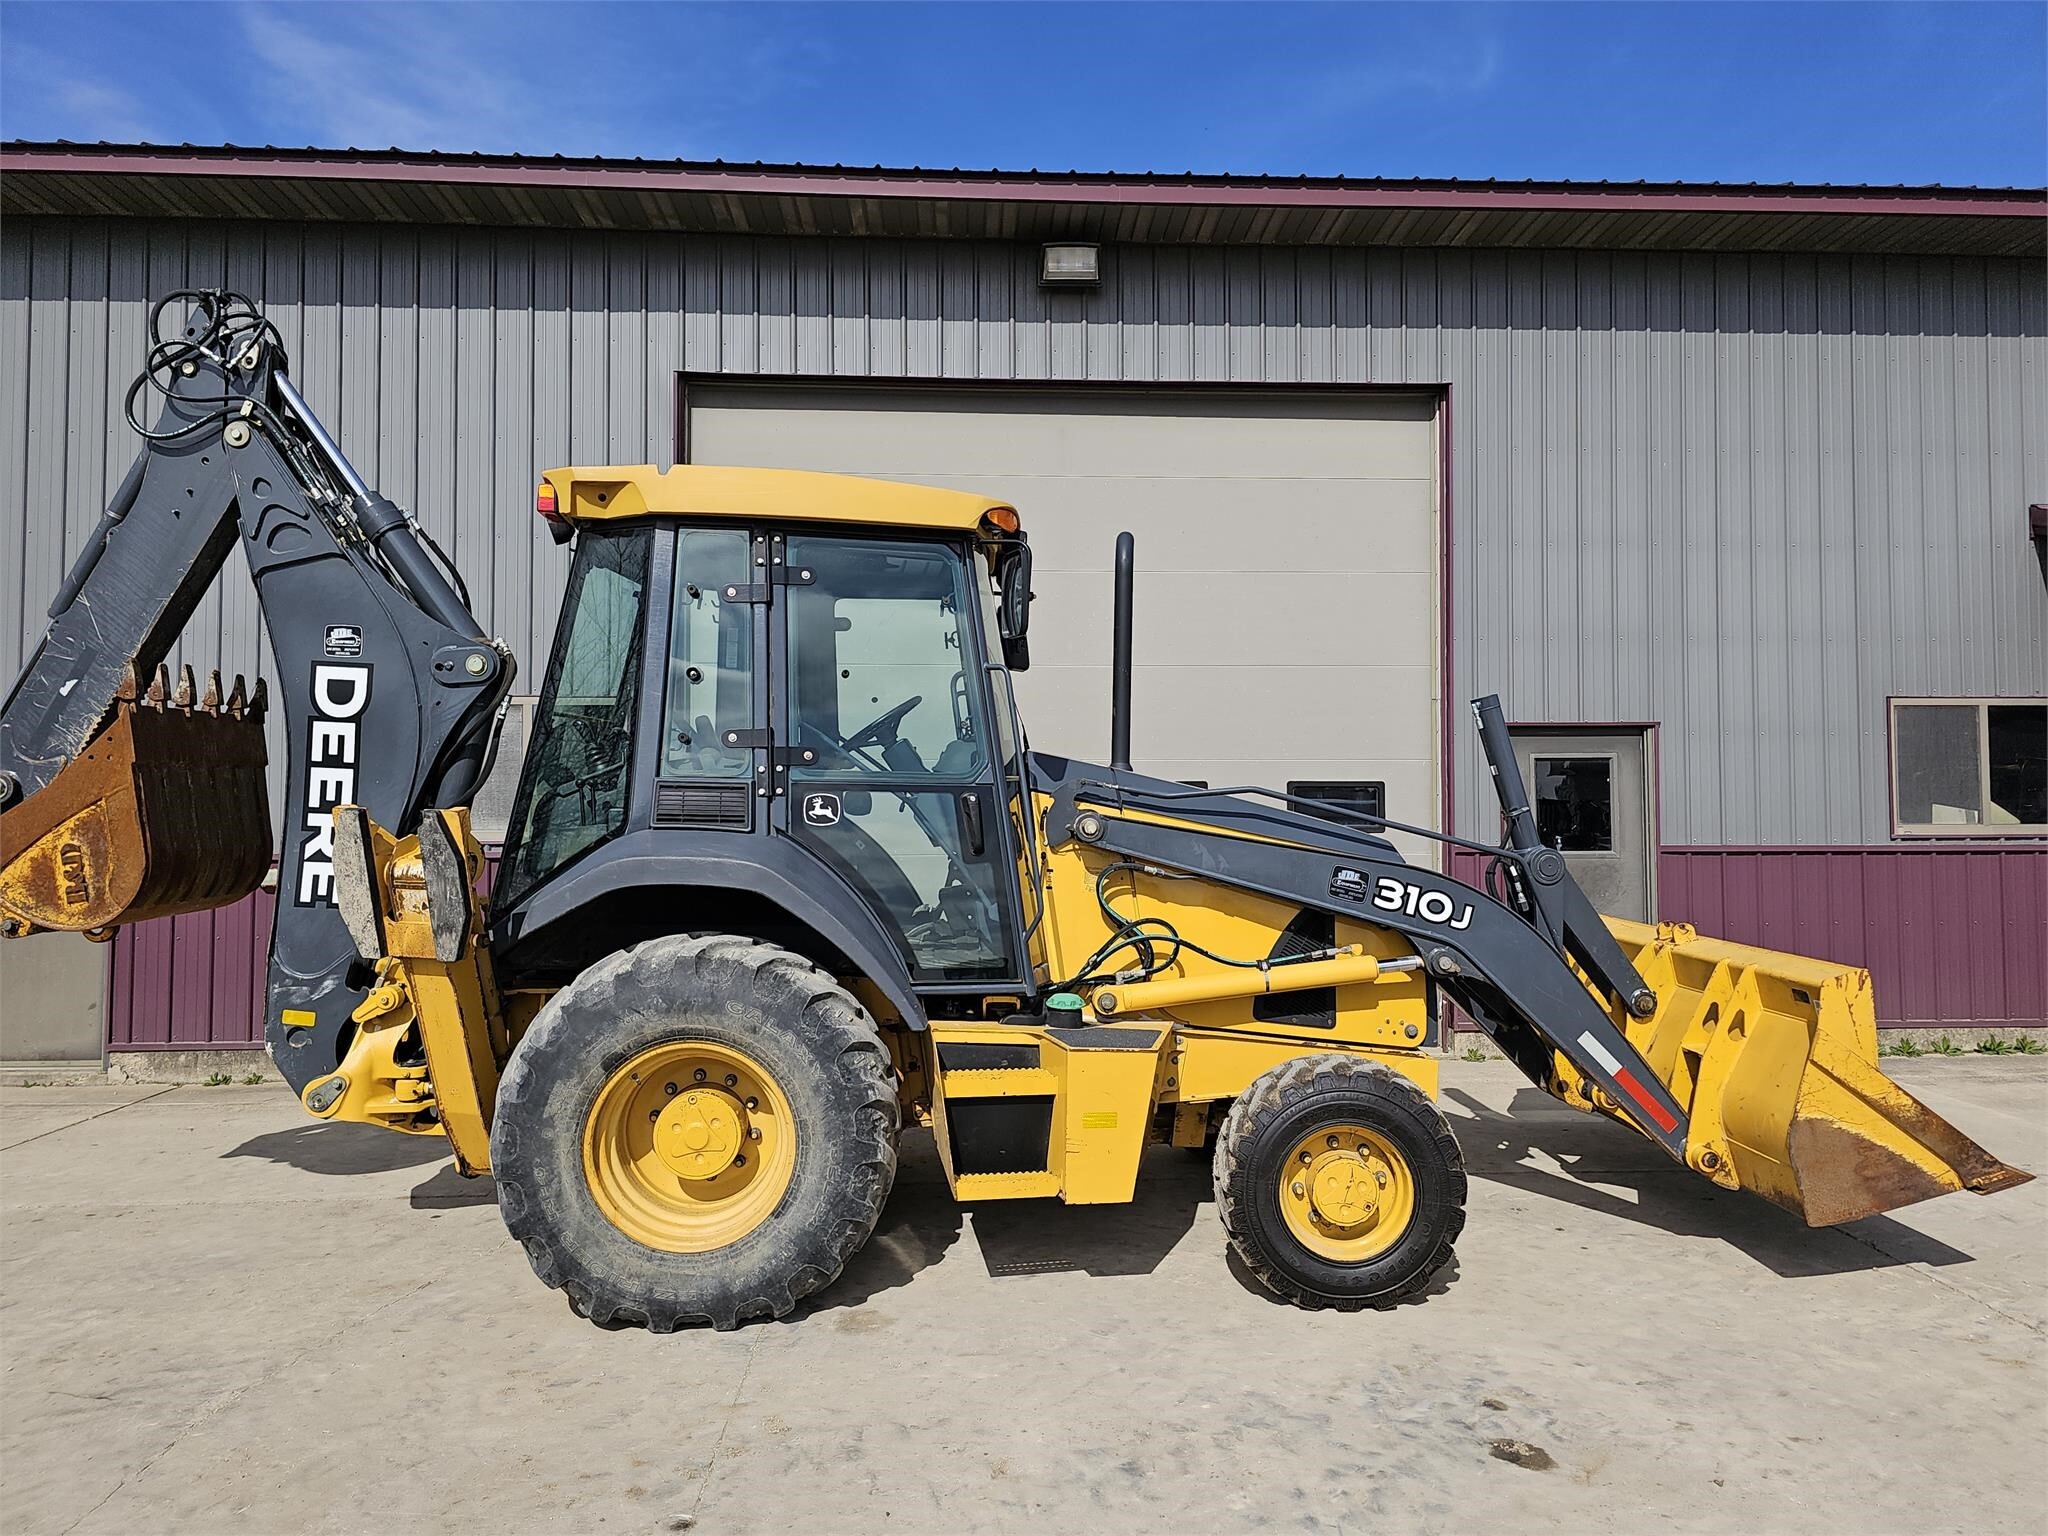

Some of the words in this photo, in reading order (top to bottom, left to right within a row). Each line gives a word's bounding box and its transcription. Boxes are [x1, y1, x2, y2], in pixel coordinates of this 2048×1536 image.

[299, 665, 368, 903] DEERE
[1373, 877, 1474, 930] 310J
[725, 999, 827, 1079] GALAXY
